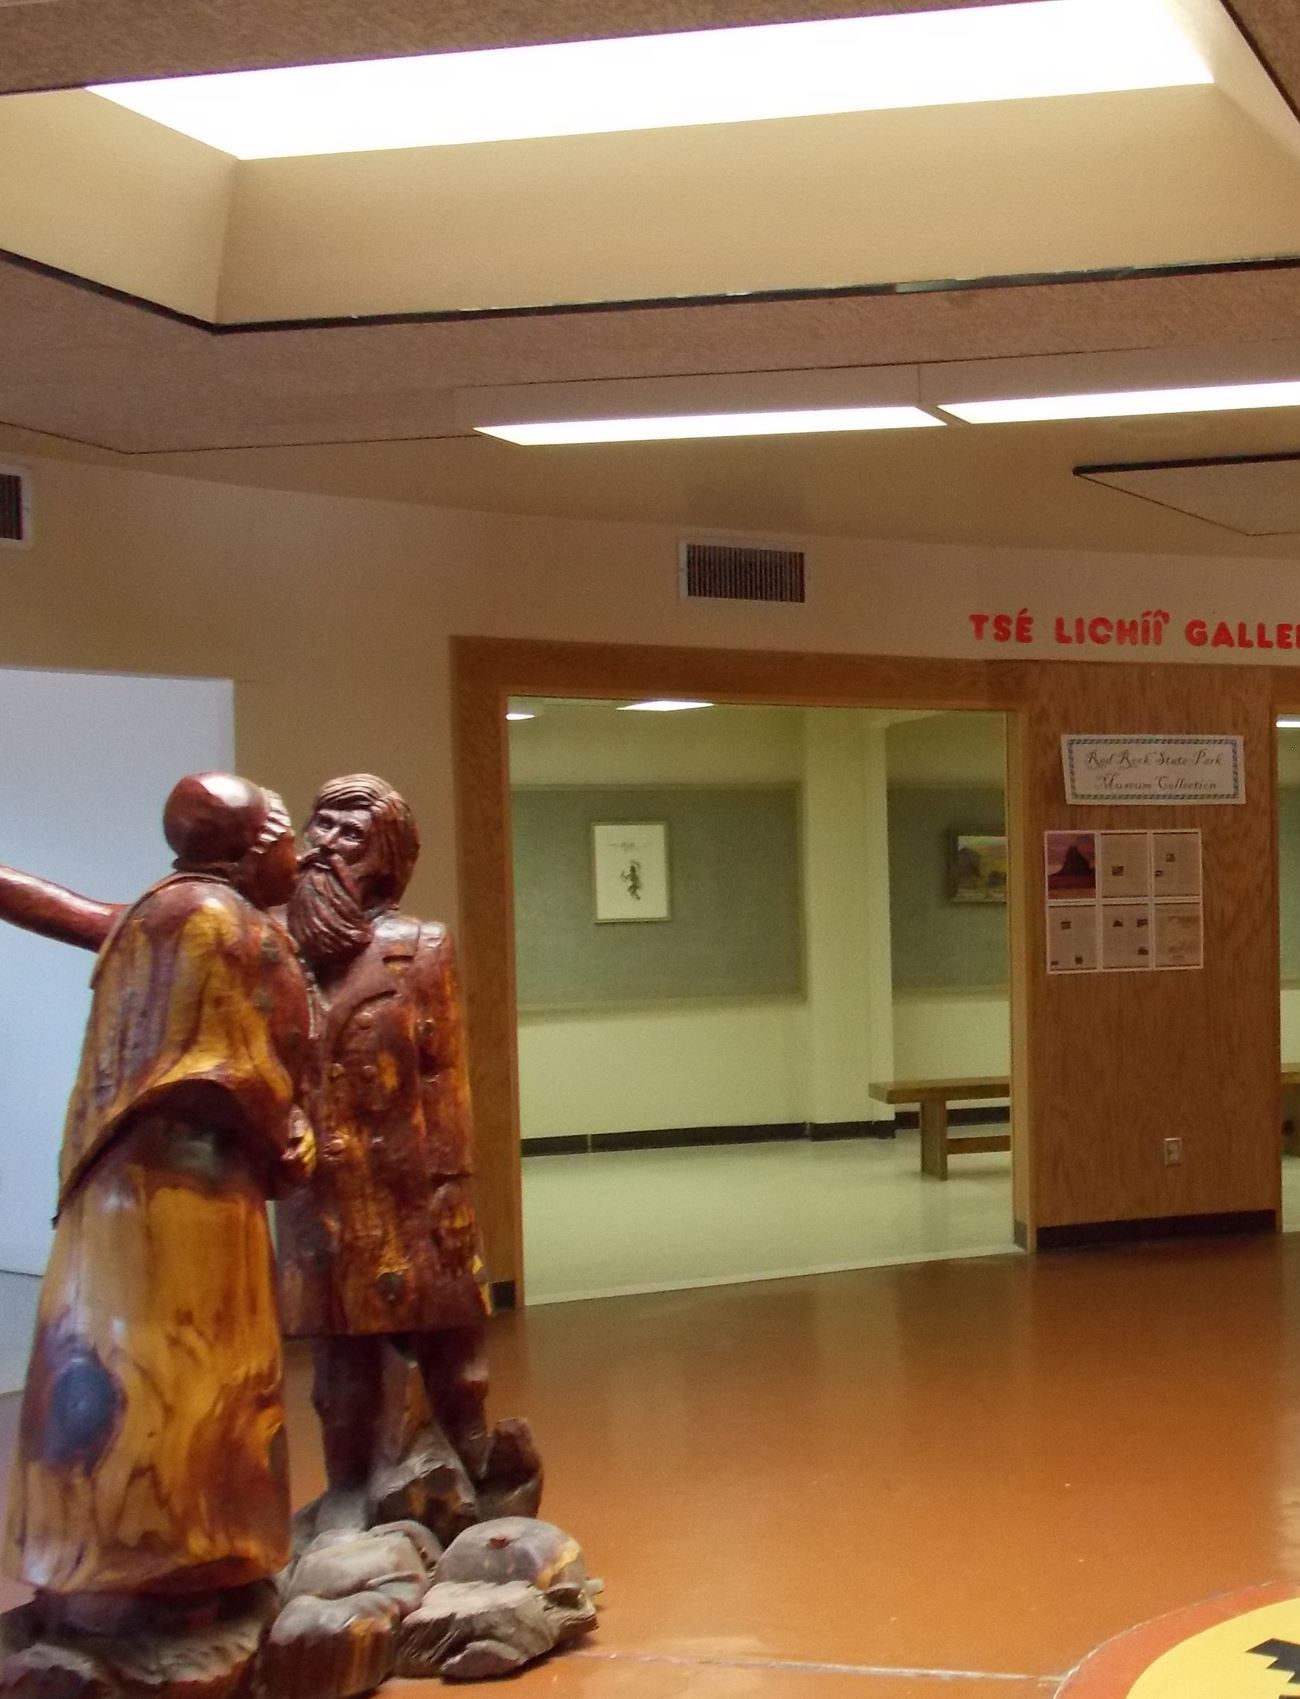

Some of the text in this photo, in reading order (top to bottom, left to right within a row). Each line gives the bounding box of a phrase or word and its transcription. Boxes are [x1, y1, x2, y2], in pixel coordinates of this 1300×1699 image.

[968, 607, 1034, 643] TSÉ
[1087, 748, 1225, 770] Red Rock State Park
[1095, 771, 1217, 790] Museum Collection
